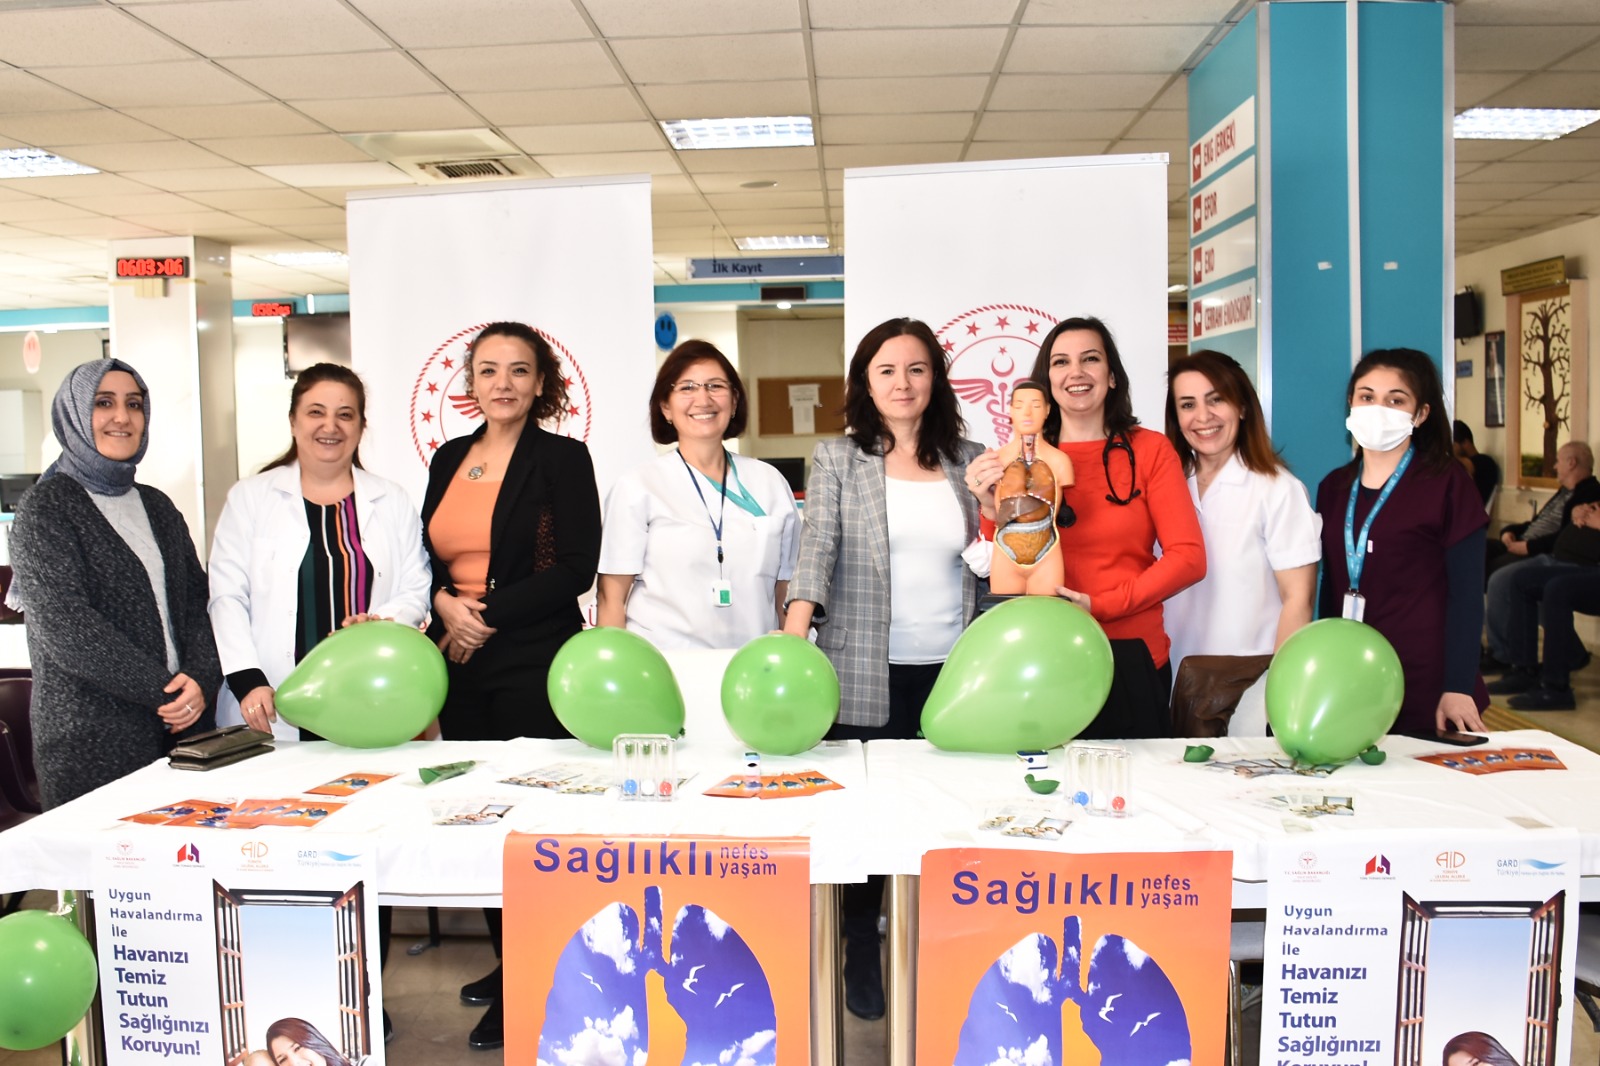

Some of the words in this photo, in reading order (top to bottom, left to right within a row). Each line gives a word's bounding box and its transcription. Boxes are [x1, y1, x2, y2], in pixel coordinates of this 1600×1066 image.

[713, 258, 728, 274] İlk
[732, 263, 762, 275] Kayıt
[297, 850, 318, 859] GARD
[720, 843, 769, 859] nefes
[534, 838, 712, 883] Sağlıklı
[1497, 858, 1519, 868] GARD
[720, 861, 778, 878] yaşam
[1142, 874, 1191, 890] nefes
[109, 888, 151, 903] Uygun
[952, 871, 1134, 914] Sağlıklı
[1141, 891, 1199, 909] yaşam
[110, 907, 203, 922] Havalandırma
[1284, 905, 1333, 920] Uygun
[112, 924, 128, 938] İle
[1283, 924, 1388, 936] Havalandırma
[114, 945, 189, 964] Havanızı
[1282, 941, 1300, 955] İle
[114, 967, 167, 986] Temiz
[1281, 963, 1367, 980] Havanızı
[116, 990, 168, 1008] Tutun
[1280, 987, 1339, 1004] Temiz
[119, 1013, 210, 1035] Sağlığınızı
[1279, 1011, 1337, 1028] Tutun
[121, 1035, 201, 1057] Koruyun!
[1278, 1035, 1381, 1056] Sağlığınızı
